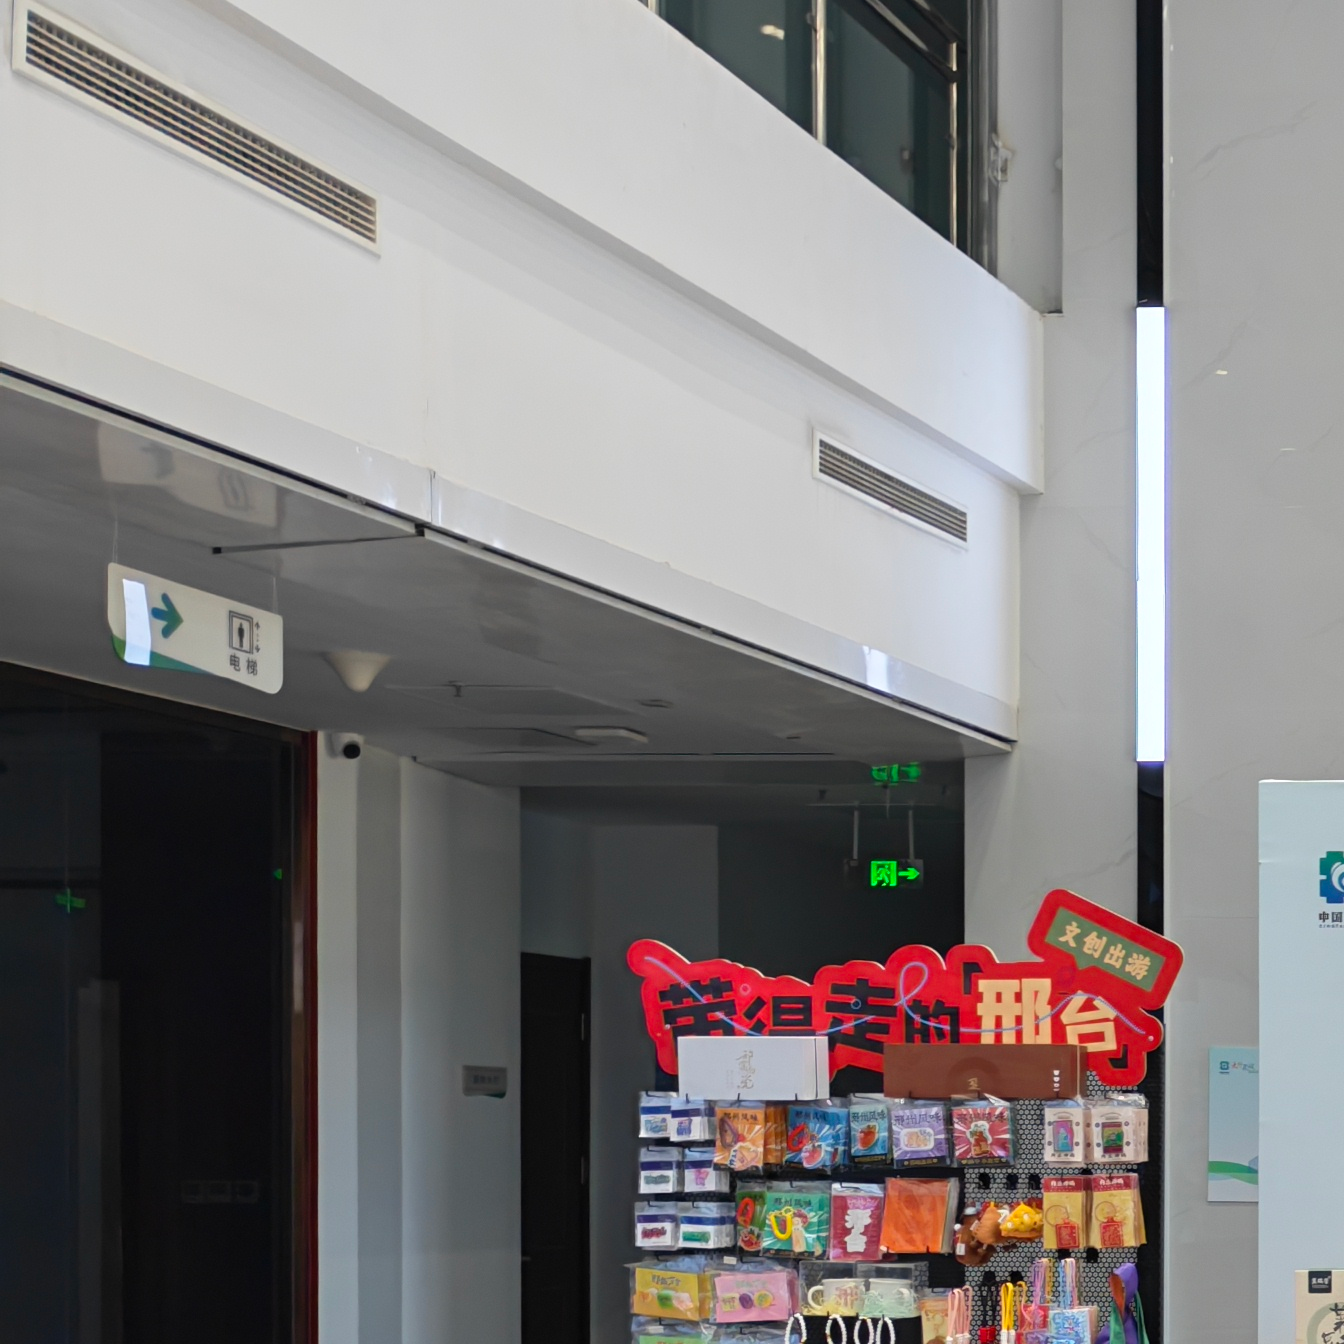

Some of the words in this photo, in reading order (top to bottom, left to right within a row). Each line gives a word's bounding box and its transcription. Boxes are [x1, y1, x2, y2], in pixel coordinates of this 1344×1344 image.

[229, 652, 258, 676] 电梯
[1057, 920, 1152, 981] 文创出游
